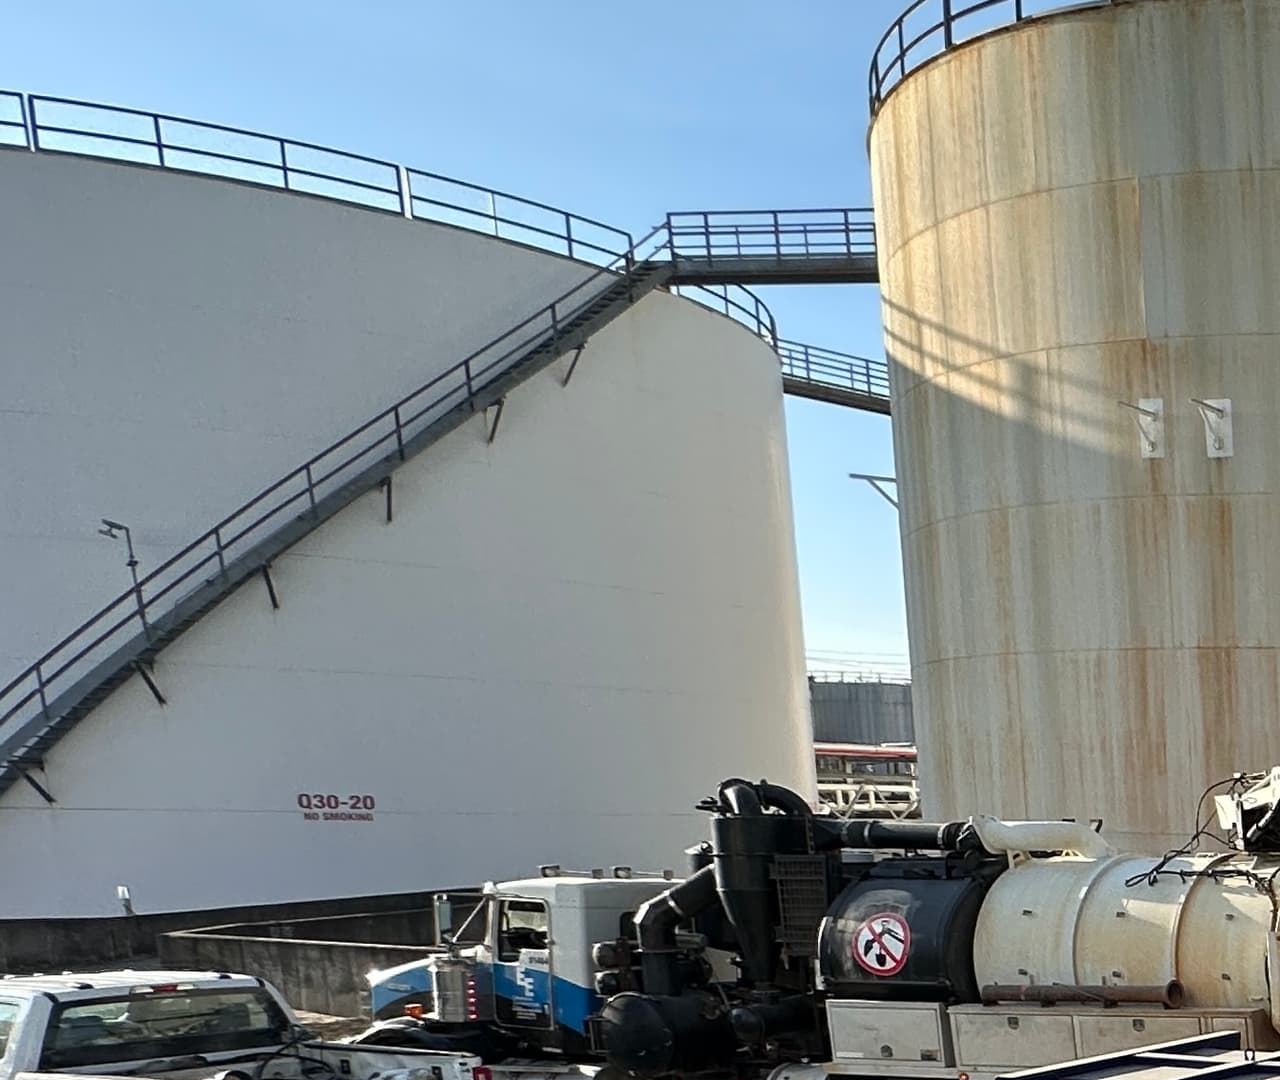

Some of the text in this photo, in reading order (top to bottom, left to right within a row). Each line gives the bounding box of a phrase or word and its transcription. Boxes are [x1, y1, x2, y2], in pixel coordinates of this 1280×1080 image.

[297, 793, 376, 810] Q30-20
[304, 812, 374, 821] NO SMOKING
